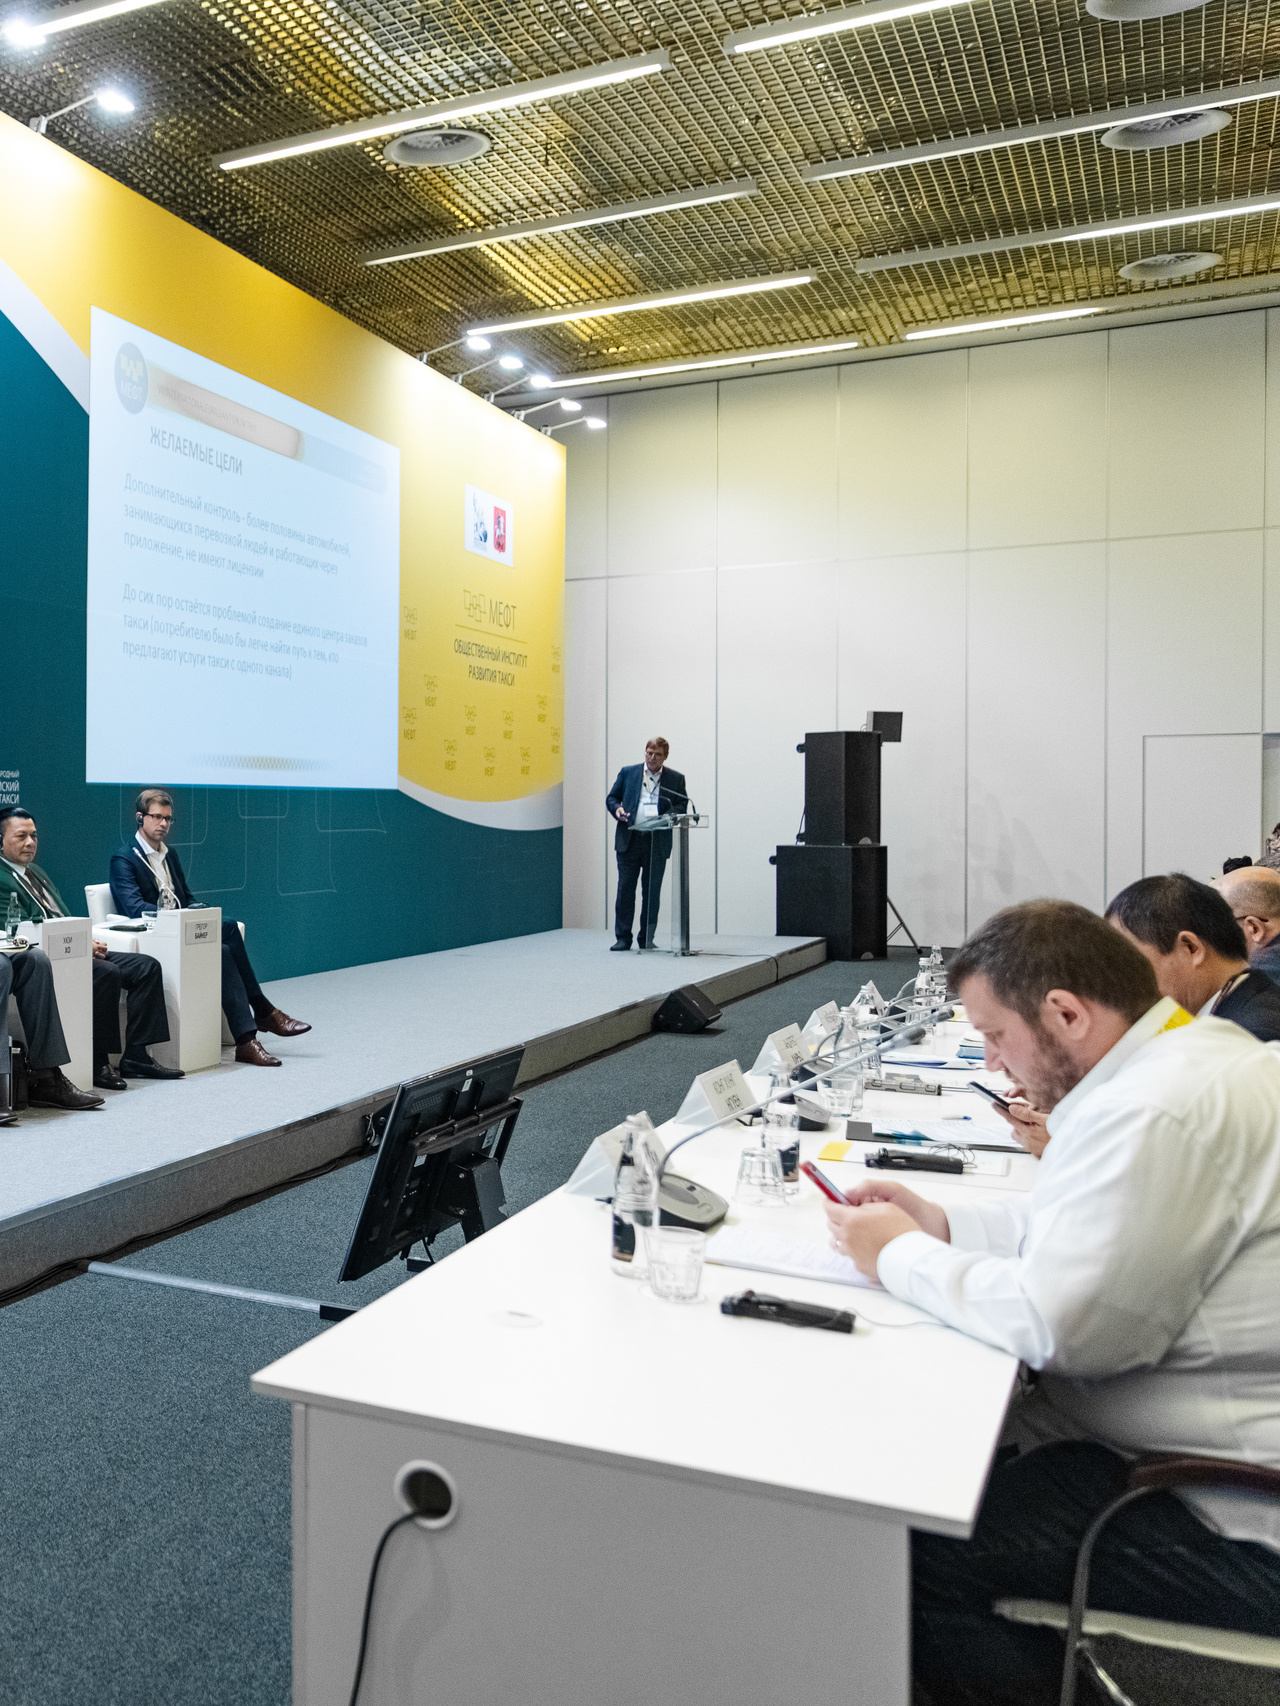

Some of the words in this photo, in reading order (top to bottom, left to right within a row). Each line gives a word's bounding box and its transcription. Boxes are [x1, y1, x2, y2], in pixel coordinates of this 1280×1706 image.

[150, 426, 214, 465] ЖЕЛАЕМЫЕ
[216, 450, 243, 476] ЦЕЛИ
[124, 473, 202, 511] Дополнительный
[204, 501, 240, 523] контроль
[246, 511, 269, 532] более
[124, 504, 192, 534] занимающихся
[194, 524, 242, 549] перевозкой
[243, 539, 268, 558] людей
[269, 546, 274, 557] и
[124, 532, 184, 562] приложение,
[186, 548, 196, 562] не
[198, 551, 225, 569] имеют
[227, 559, 264, 578] лицензии
[123, 583, 136, 603] До
[139, 590, 154, 604] сих
[157, 594, 173, 611] пор
[212, 605, 256, 625] проблемой
[258, 615, 291, 632] создание
[293, 623, 320, 638] единого
[322, 629, 344, 644] центра
[123, 614, 148, 630] такси
[150, 615, 211, 642] (потребителю
[212, 628, 233, 645] было
[235, 632, 246, 648] бы
[248, 637, 268, 652] легче
[270, 640, 290, 655] найти
[489, 599, 516, 630] МЕФТ
[123, 641, 177, 661] предлагают
[178, 651, 205, 668] услуги
[208, 655, 229, 668] такси
[237, 660, 263, 675] одного
[265, 664, 292, 681] канала)
[454, 639, 500, 661] ОБЩЕСТВЕННЫЙ
[469, 665, 496, 683] РАЗВИТИЯ
[498, 670, 515, 686] ТАКСИ
